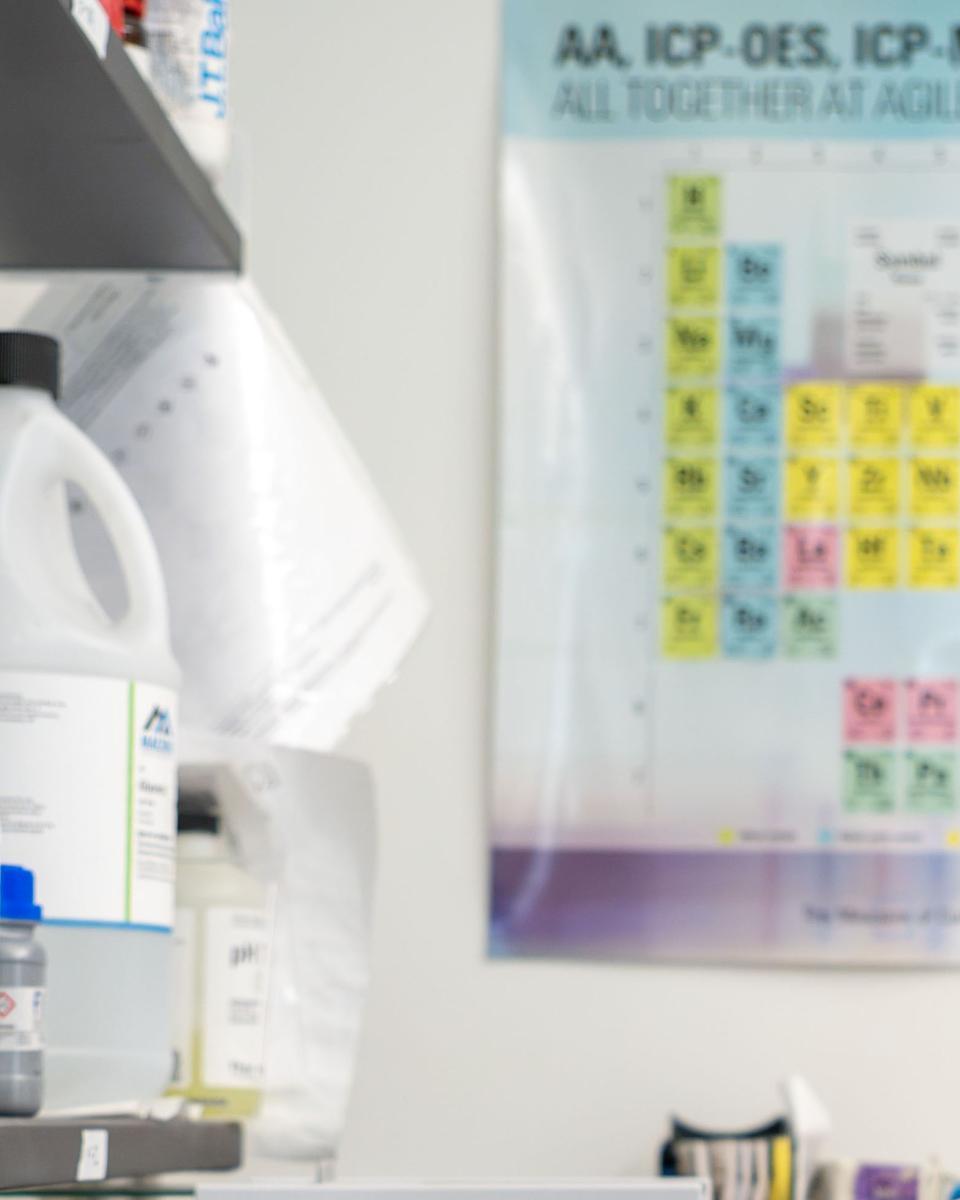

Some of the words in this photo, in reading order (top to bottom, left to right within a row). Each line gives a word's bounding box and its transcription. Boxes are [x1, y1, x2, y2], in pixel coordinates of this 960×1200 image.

[553, 23, 631, 70] AA,
[645, 23, 840, 71] ICP-OES,
[551, 78, 613, 122] ALL
[626, 78, 812, 122] TOGETHER
[816, 78, 863, 121] AT
